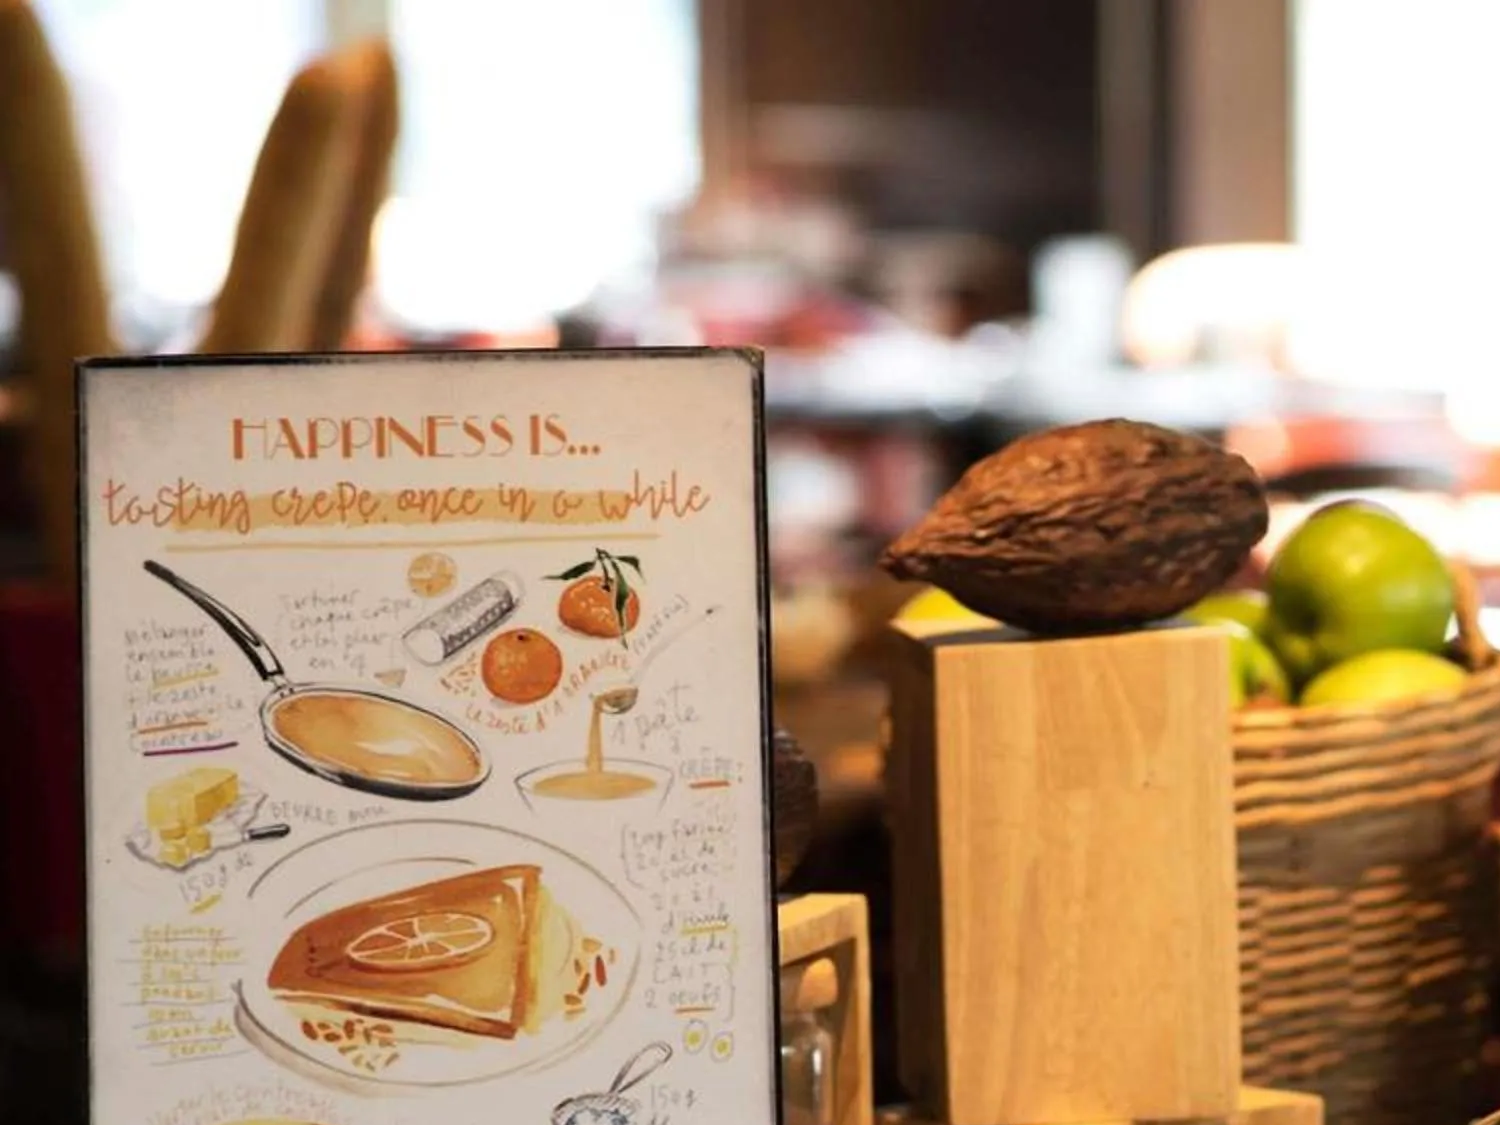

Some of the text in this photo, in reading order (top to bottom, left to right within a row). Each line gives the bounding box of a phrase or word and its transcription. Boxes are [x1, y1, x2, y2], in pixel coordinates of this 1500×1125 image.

[232, 413, 601, 460] HAPPINESS IS...
[103, 476, 251, 535] tasting
[397, 487, 483, 523] once
[499, 482, 536, 523] in
[552, 489, 582, 519] a
[600, 468, 711, 520] while
